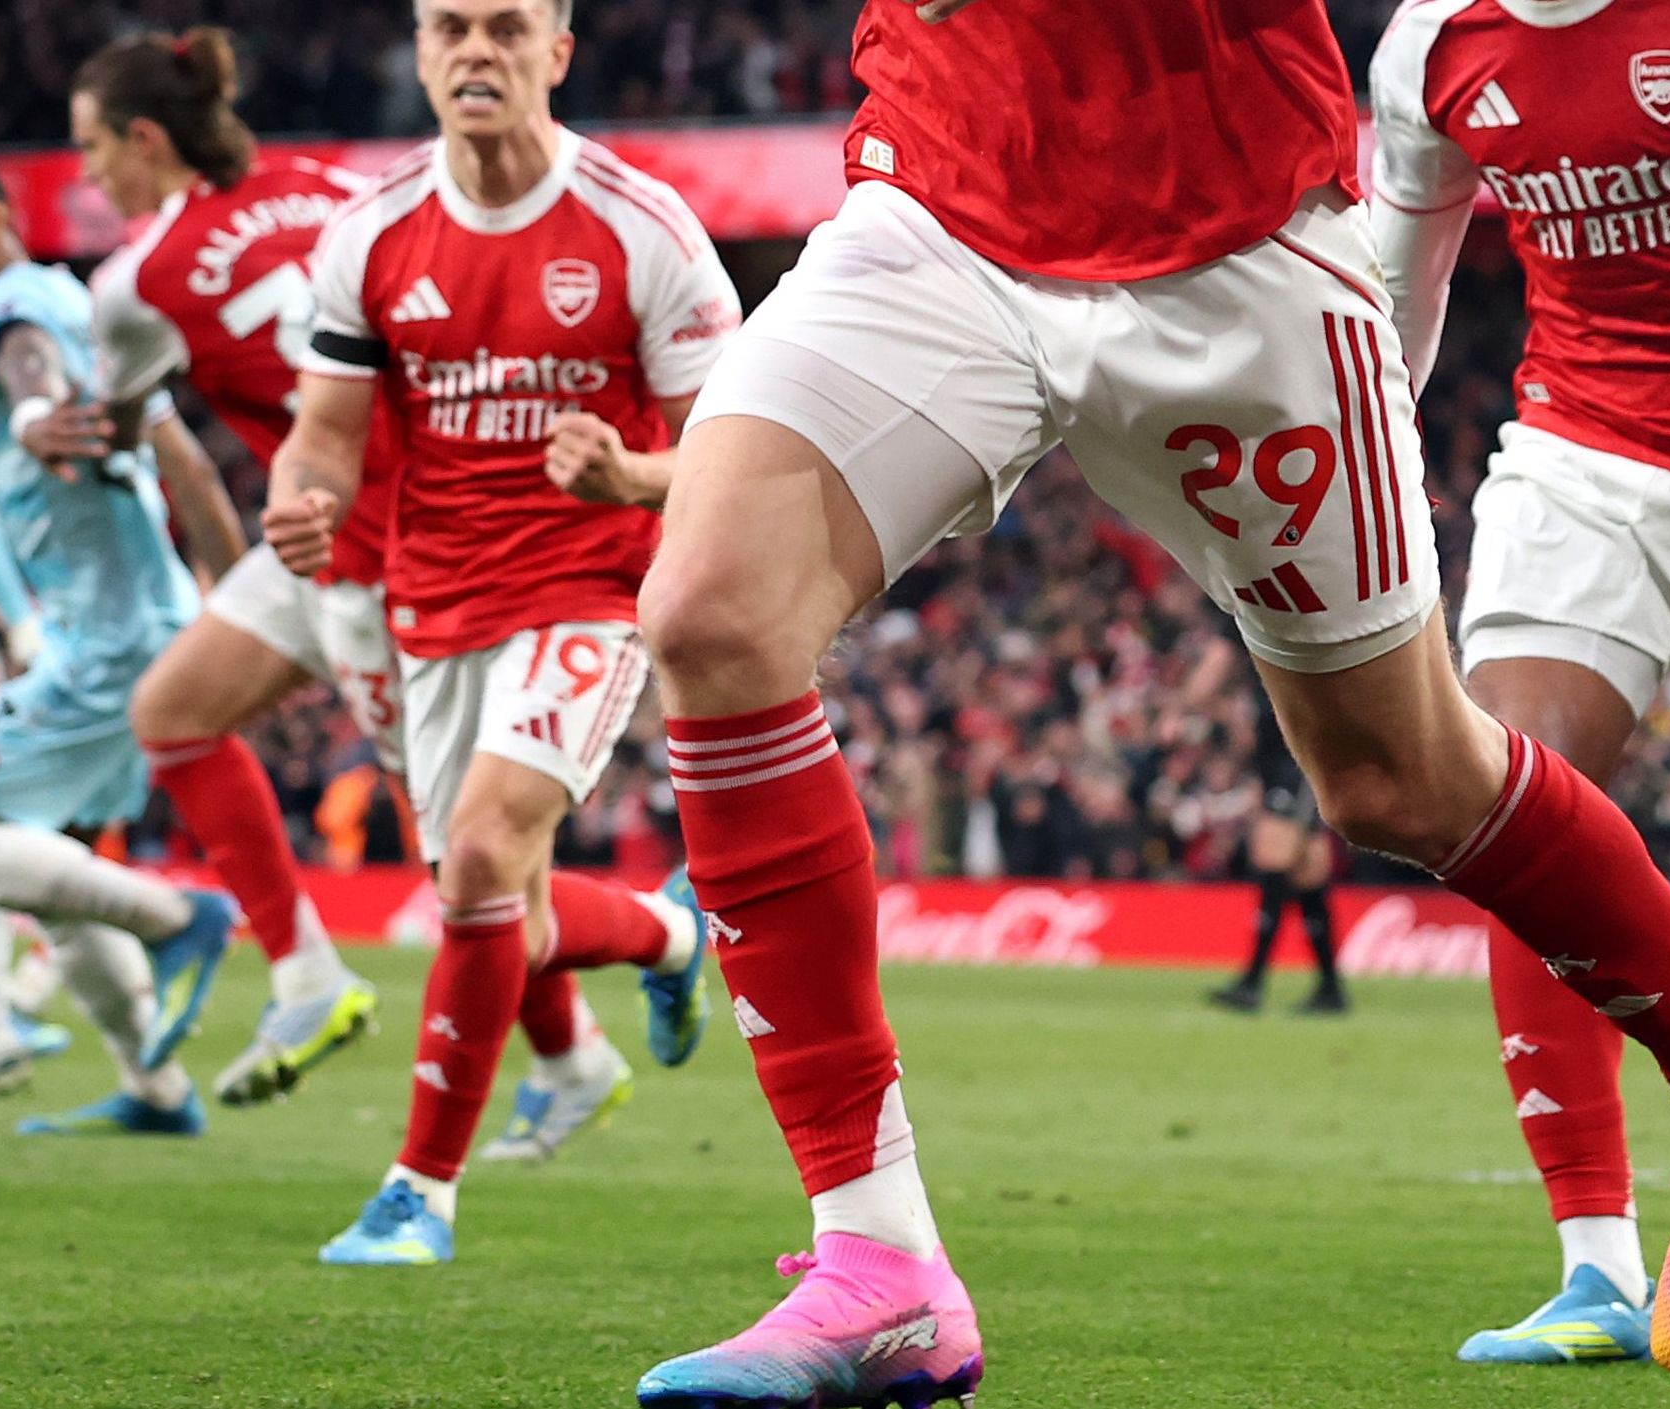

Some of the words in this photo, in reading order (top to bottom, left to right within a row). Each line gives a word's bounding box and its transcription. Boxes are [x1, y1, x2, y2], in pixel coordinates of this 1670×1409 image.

[400, 346, 610, 397] Emirates
[1164, 423, 1337, 547] 29
[521, 626, 607, 703] 19
